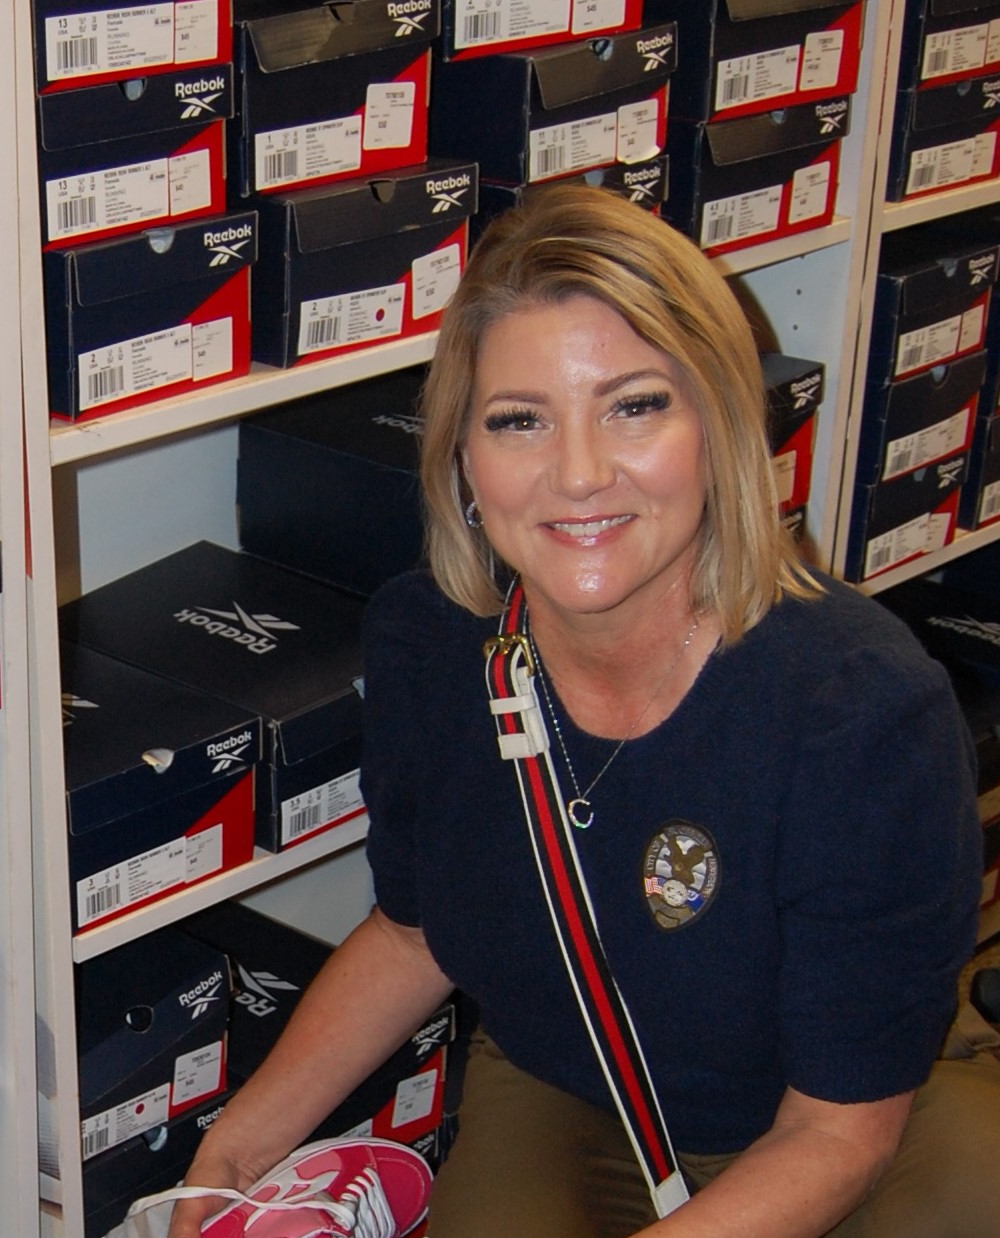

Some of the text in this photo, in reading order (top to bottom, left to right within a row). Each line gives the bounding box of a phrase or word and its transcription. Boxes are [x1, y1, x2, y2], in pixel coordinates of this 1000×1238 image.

[388, 0, 432, 17] Reebok
[58, 18, 67, 29] 13
[636, 33, 673, 53] Reebok
[175, 76, 225, 98] Reebok
[815, 100, 848, 117] Reebok
[59, 180, 67, 190] 13
[426, 174, 471, 194] Reebok
[624, 166, 661, 185] Reebok
[204, 224, 252, 247] Reebok
[790, 373, 822, 396] Reebok
[172, 608, 278, 655] Reebok
[206, 731, 252, 757] Reebok
[178, 970, 223, 1006] Reebok
